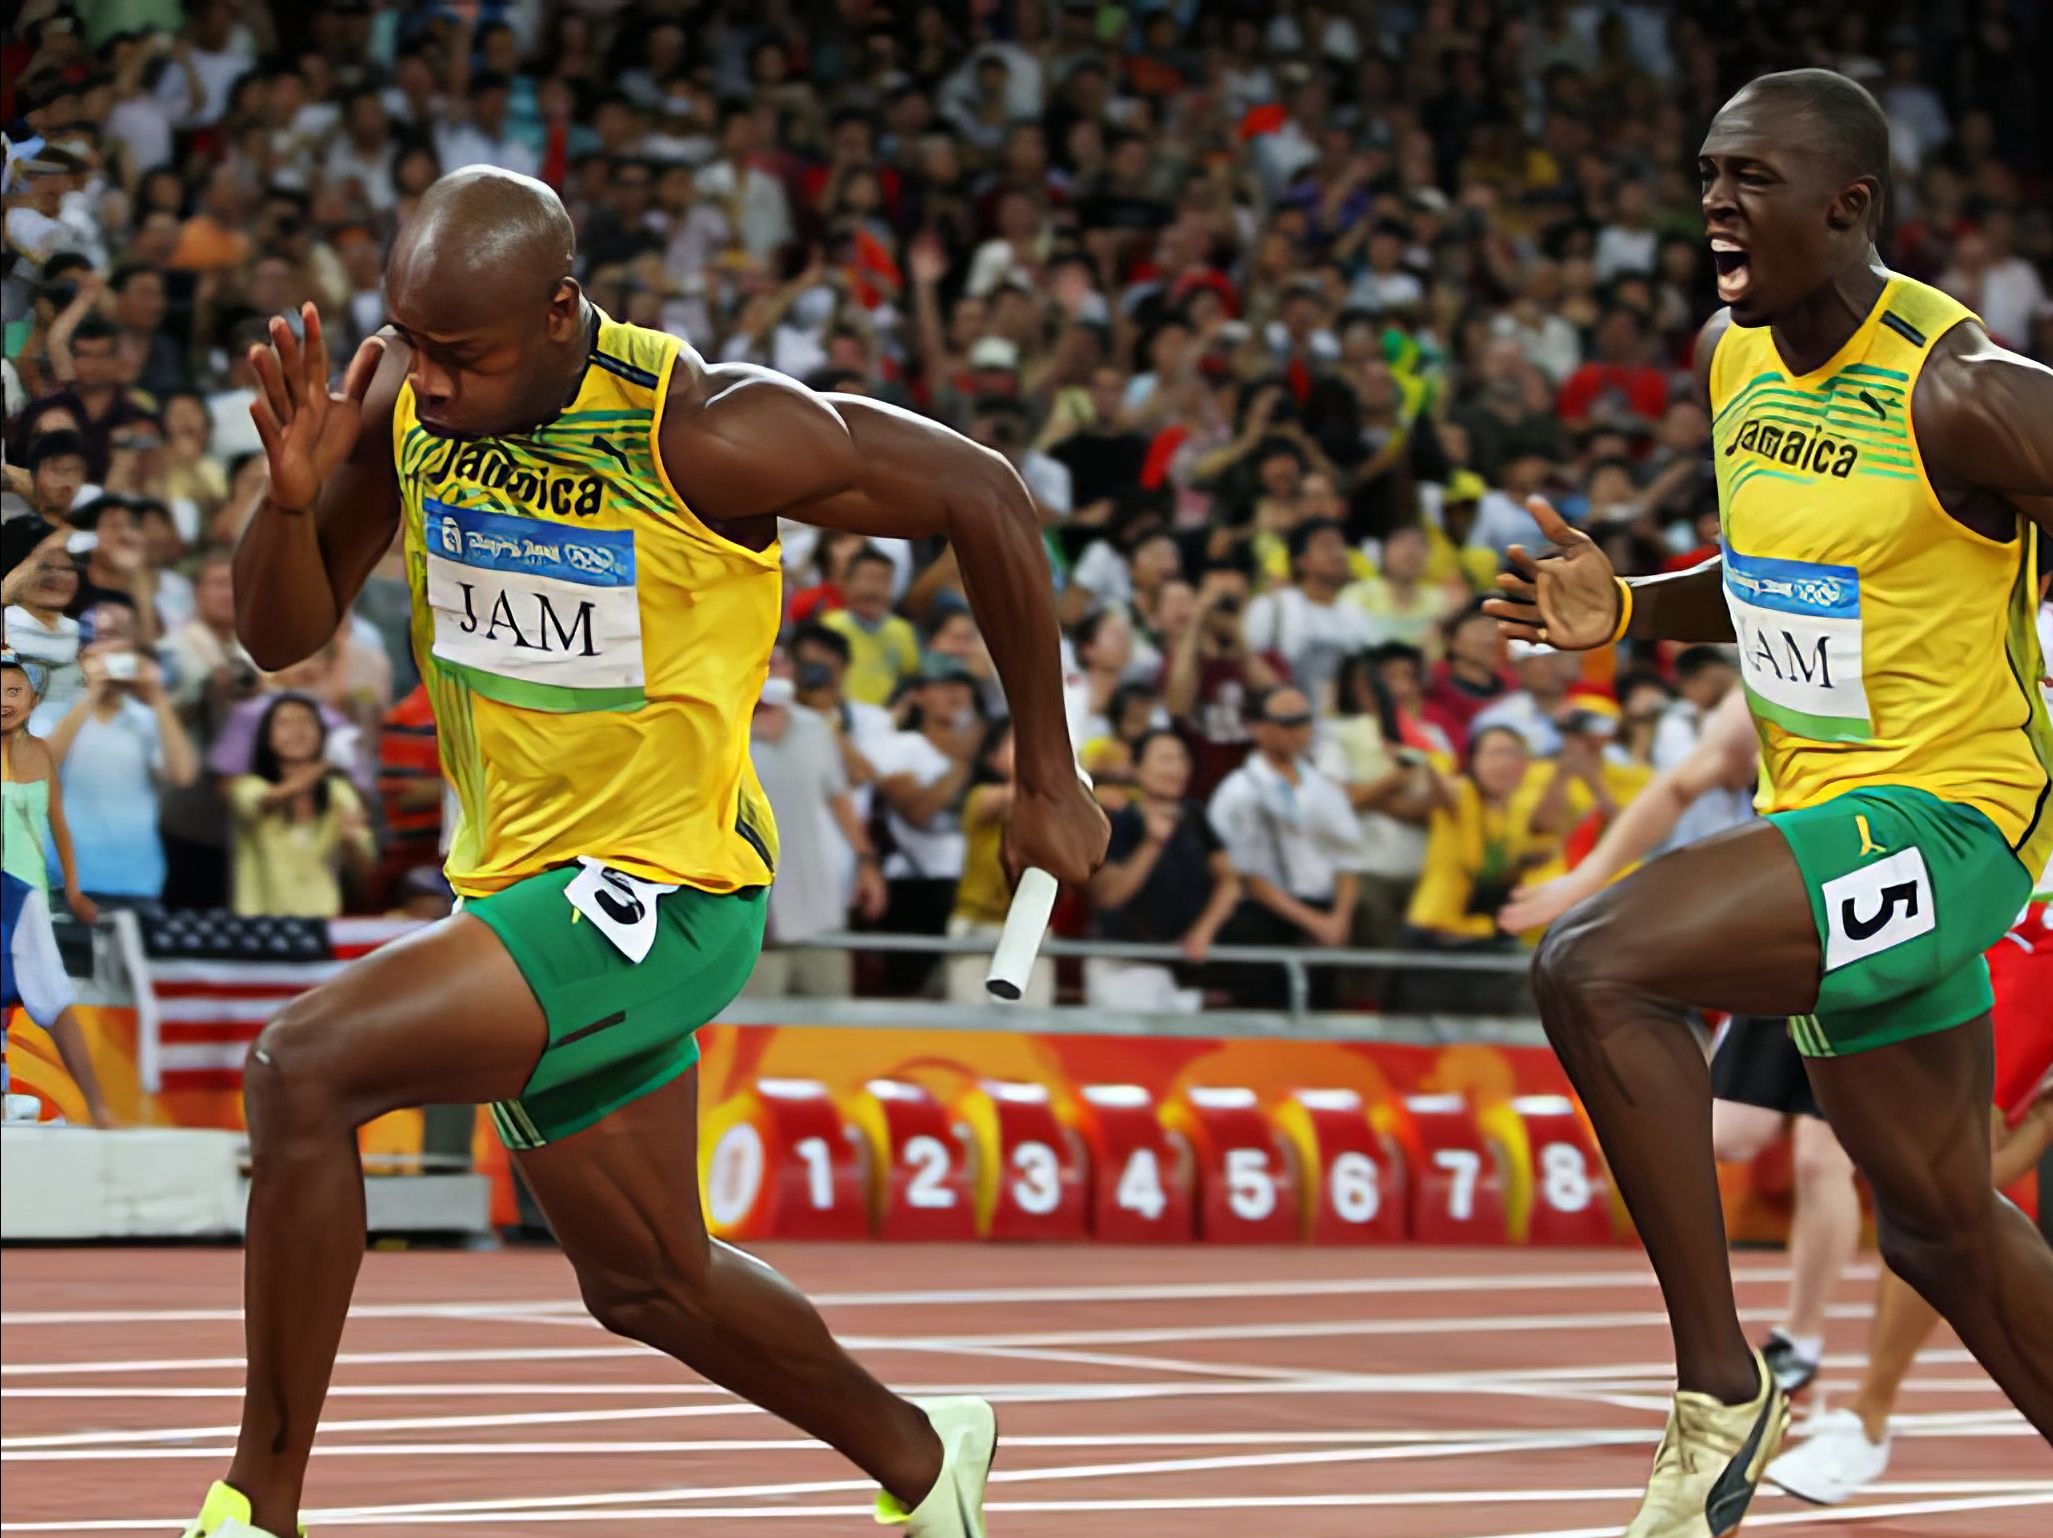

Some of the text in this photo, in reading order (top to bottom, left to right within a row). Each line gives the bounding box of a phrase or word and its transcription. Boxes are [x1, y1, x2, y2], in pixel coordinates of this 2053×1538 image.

[456, 582, 602, 657] JAM
[1744, 627, 1834, 689] AM
[1842, 880, 1918, 940] 5
[795, 1137, 834, 1210] 1
[904, 1135, 957, 1209] 2
[1012, 1141, 1061, 1215] 3
[1116, 1149, 1166, 1220] 4
[1224, 1147, 1277, 1221] 5
[1329, 1151, 1380, 1224] 6
[1434, 1149, 1481, 1221] 7
[1541, 1142, 1592, 1213] 8
